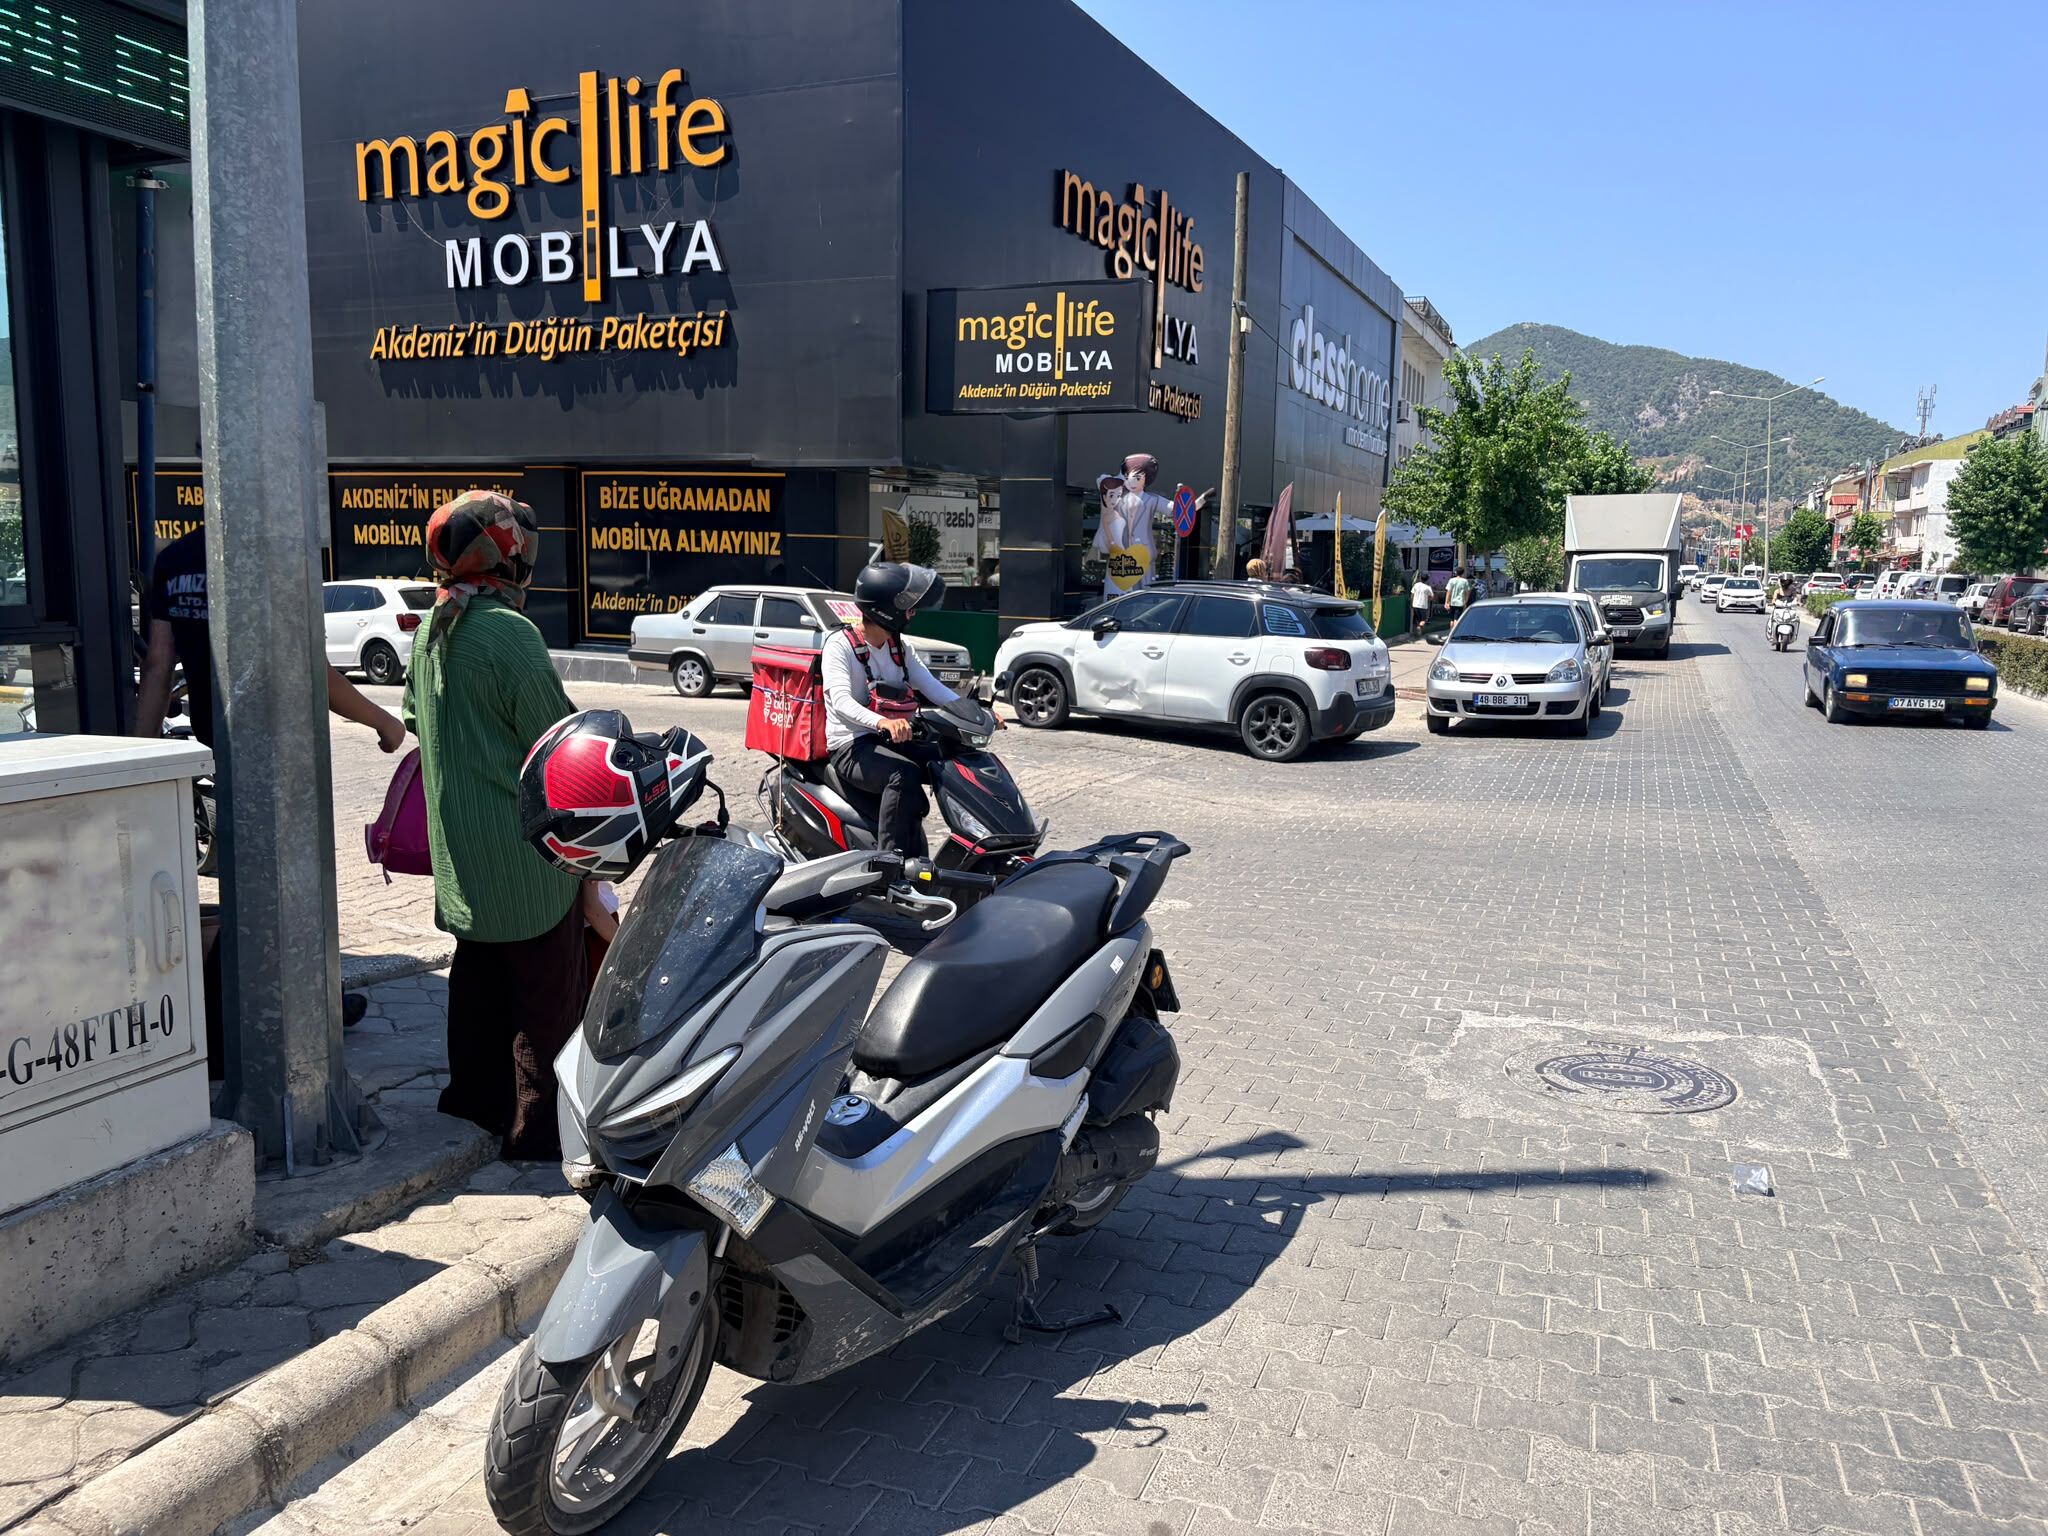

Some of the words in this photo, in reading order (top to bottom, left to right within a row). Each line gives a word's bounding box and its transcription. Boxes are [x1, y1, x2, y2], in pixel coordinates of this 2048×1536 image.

[355, 87, 571, 219] magic
[607, 68, 727, 176] life
[1062, 169, 1158, 279] magic
[1167, 205, 1204, 292] life
[504, 317, 592, 361] Düğün
[600, 310, 728, 357] Paketçisi
[958, 302, 1052, 350] magic
[1067, 299, 1115, 337] life
[1163, 313, 1200, 365] LYA
[1019, 381, 1057, 400] Düğün
[1059, 381, 1112, 397] Paketçisi
[1149, 380, 1162, 408] ün
[176, 486, 204, 506] FAB
[600, 480, 639, 509] BİZE
[643, 481, 770, 513] UĞRAMADAN
[354, 520, 422, 546] MOBİLYA
[591, 522, 672, 552] MOBİLYA
[676, 529, 781, 556] ALMAYINIZ
[1479, 695, 1490, 704] 48
[1513, 696, 1527, 705] 311
[1893, 698, 1905, 708] 07
[1906, 698, 1925, 708] AVG
[1927, 699, 1944, 709] 134
